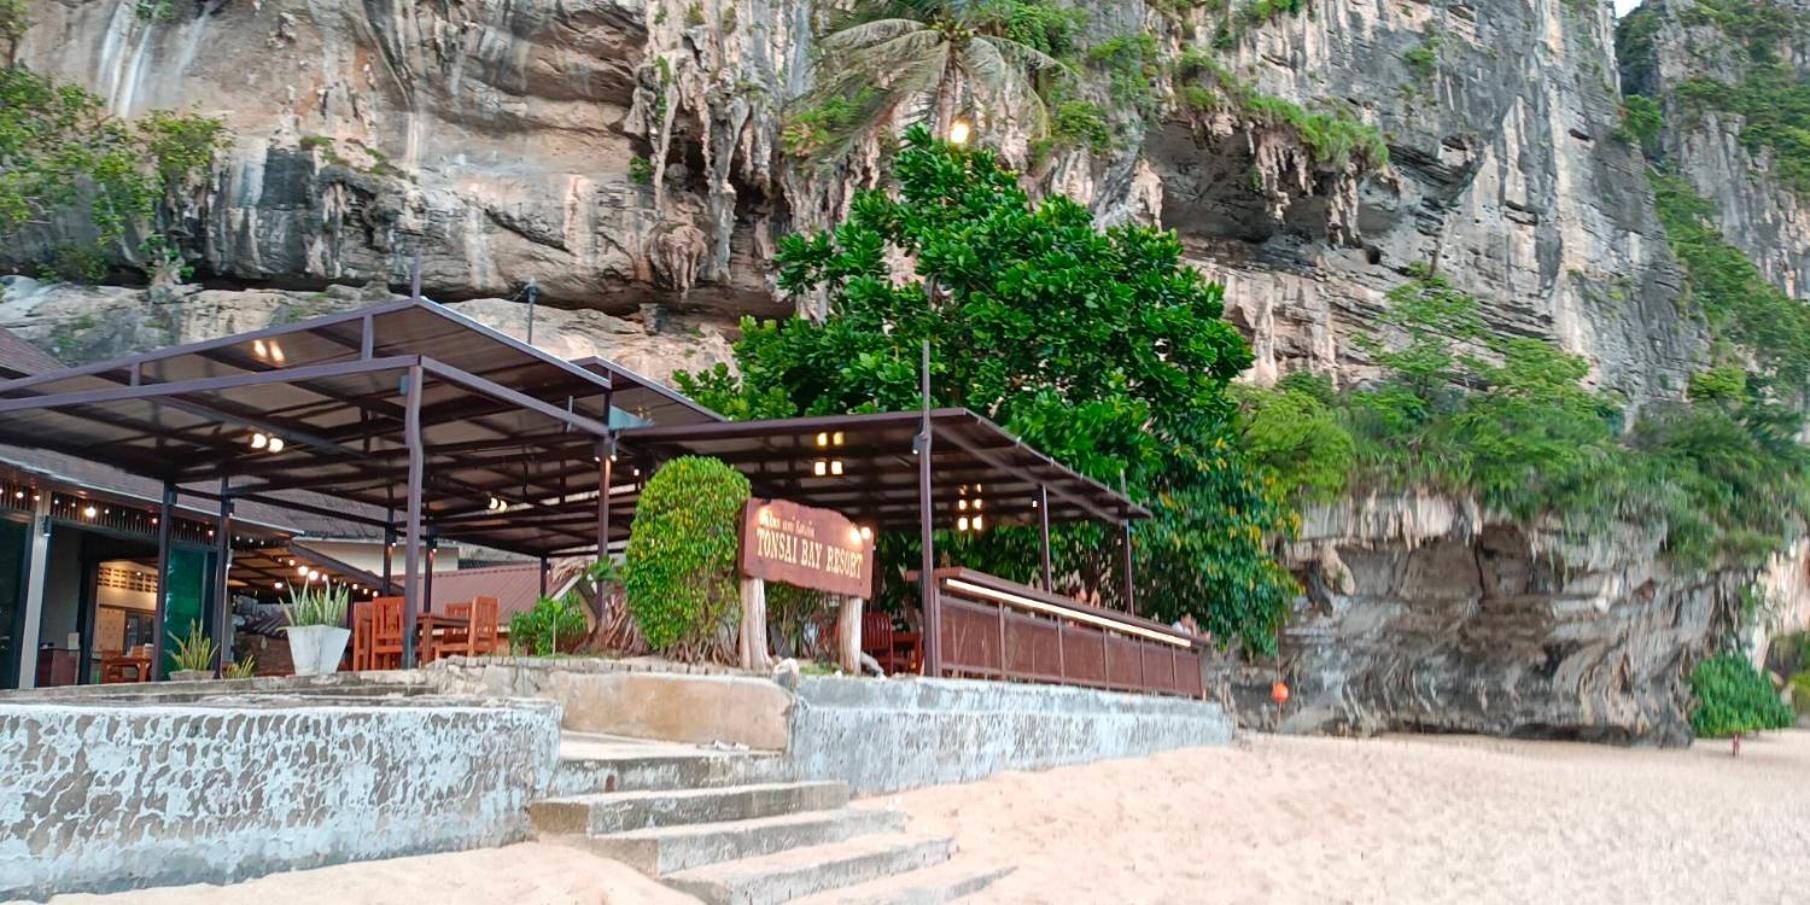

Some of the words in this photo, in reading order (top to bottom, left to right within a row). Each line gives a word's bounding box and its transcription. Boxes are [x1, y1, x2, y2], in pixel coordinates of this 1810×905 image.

[756, 528, 798, 565] TONSAI
[800, 540, 823, 570] BAY
[826, 544, 864, 580] RESORT
